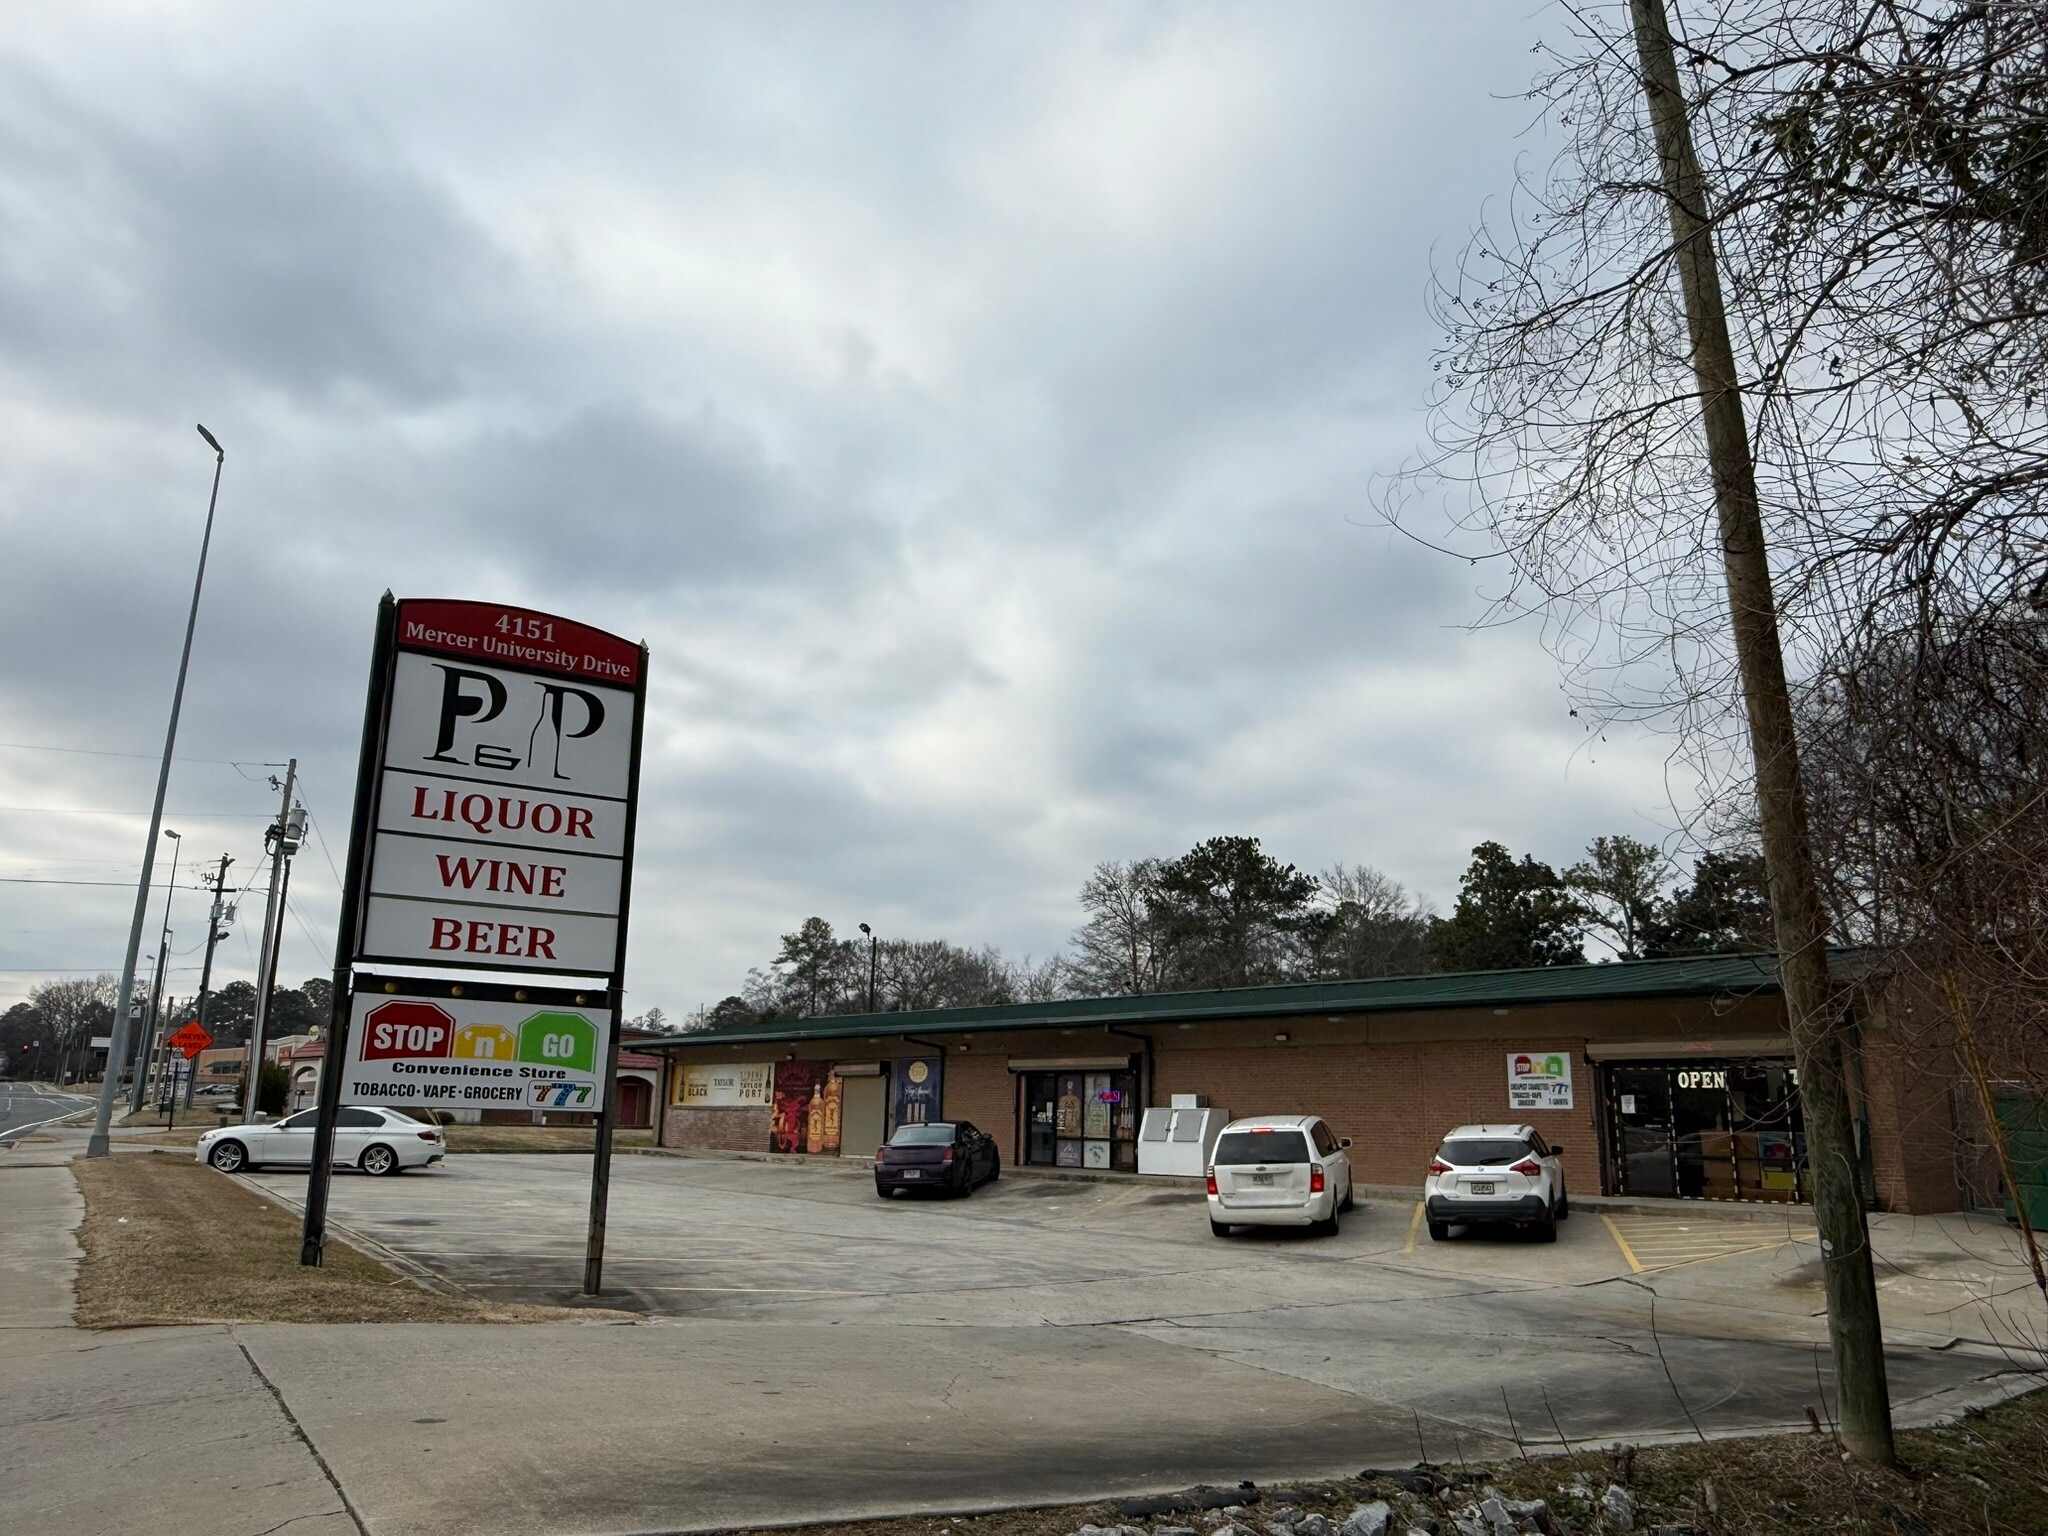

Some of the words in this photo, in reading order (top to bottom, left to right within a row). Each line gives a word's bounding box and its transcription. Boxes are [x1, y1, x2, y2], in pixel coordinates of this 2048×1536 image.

[494, 613, 556, 643] 4151
[406, 621, 478, 651] Mercer
[482, 636, 579, 671] University
[582, 655, 631, 679] Drive
[410, 785, 596, 840] LIQUOR
[435, 854, 568, 898] WINE
[428, 917, 557, 960] BEER
[373, 1022, 445, 1052] STOP
[542, 1033, 575, 1058] GO
[392, 1061, 513, 1077] Convenience
[518, 1066, 567, 1080] Store
[1677, 1071, 1726, 1089] OPEN
[533, 1082, 592, 1107] 777
[687, 1088, 709, 1097] BLACK
[738, 1089, 762, 1098] PORT
